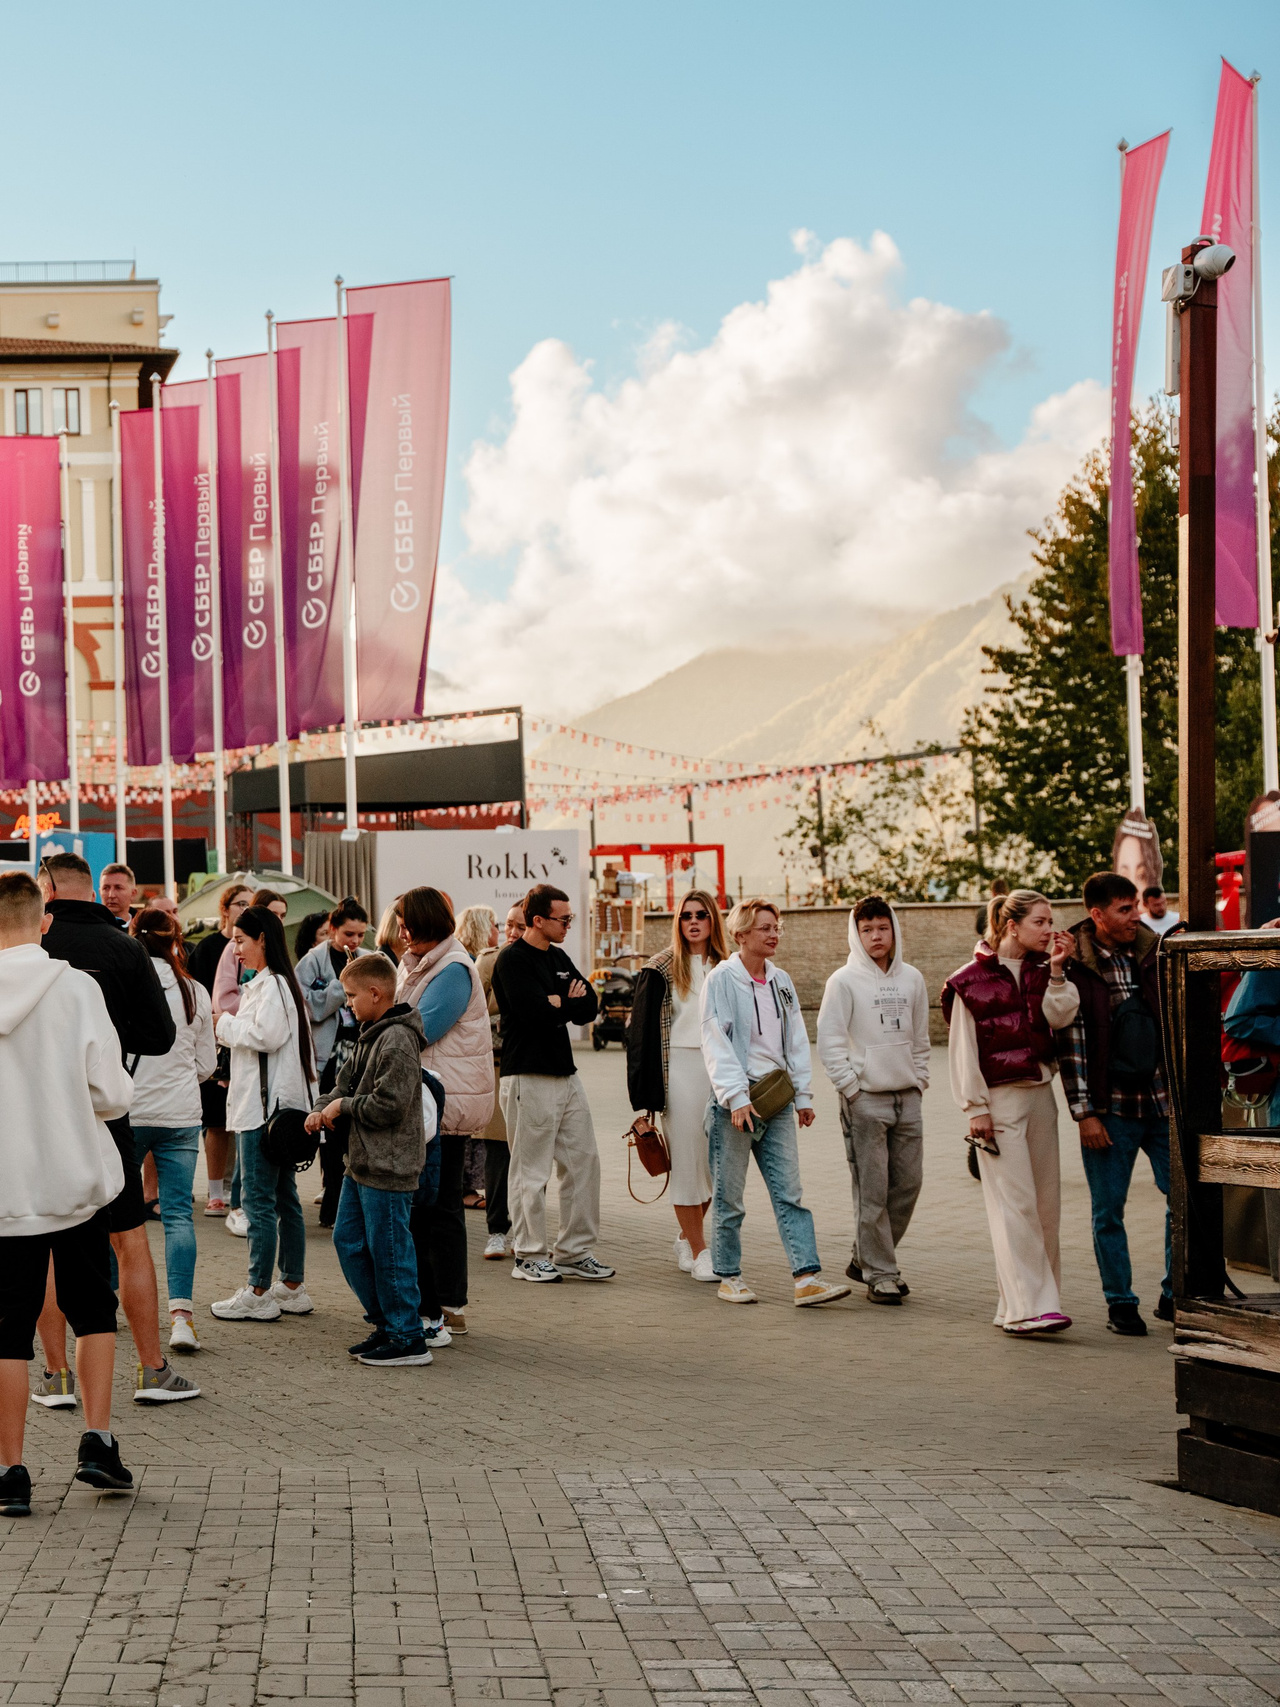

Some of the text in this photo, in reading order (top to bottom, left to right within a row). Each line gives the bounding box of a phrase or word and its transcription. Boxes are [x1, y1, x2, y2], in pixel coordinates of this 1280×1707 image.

[194, 473, 211, 628] СБЕР Первый
[248, 453, 269, 615] СБЕР Первый
[307, 421, 331, 592] СБЕР Первый
[392, 393, 417, 573] СБЕР Первый
